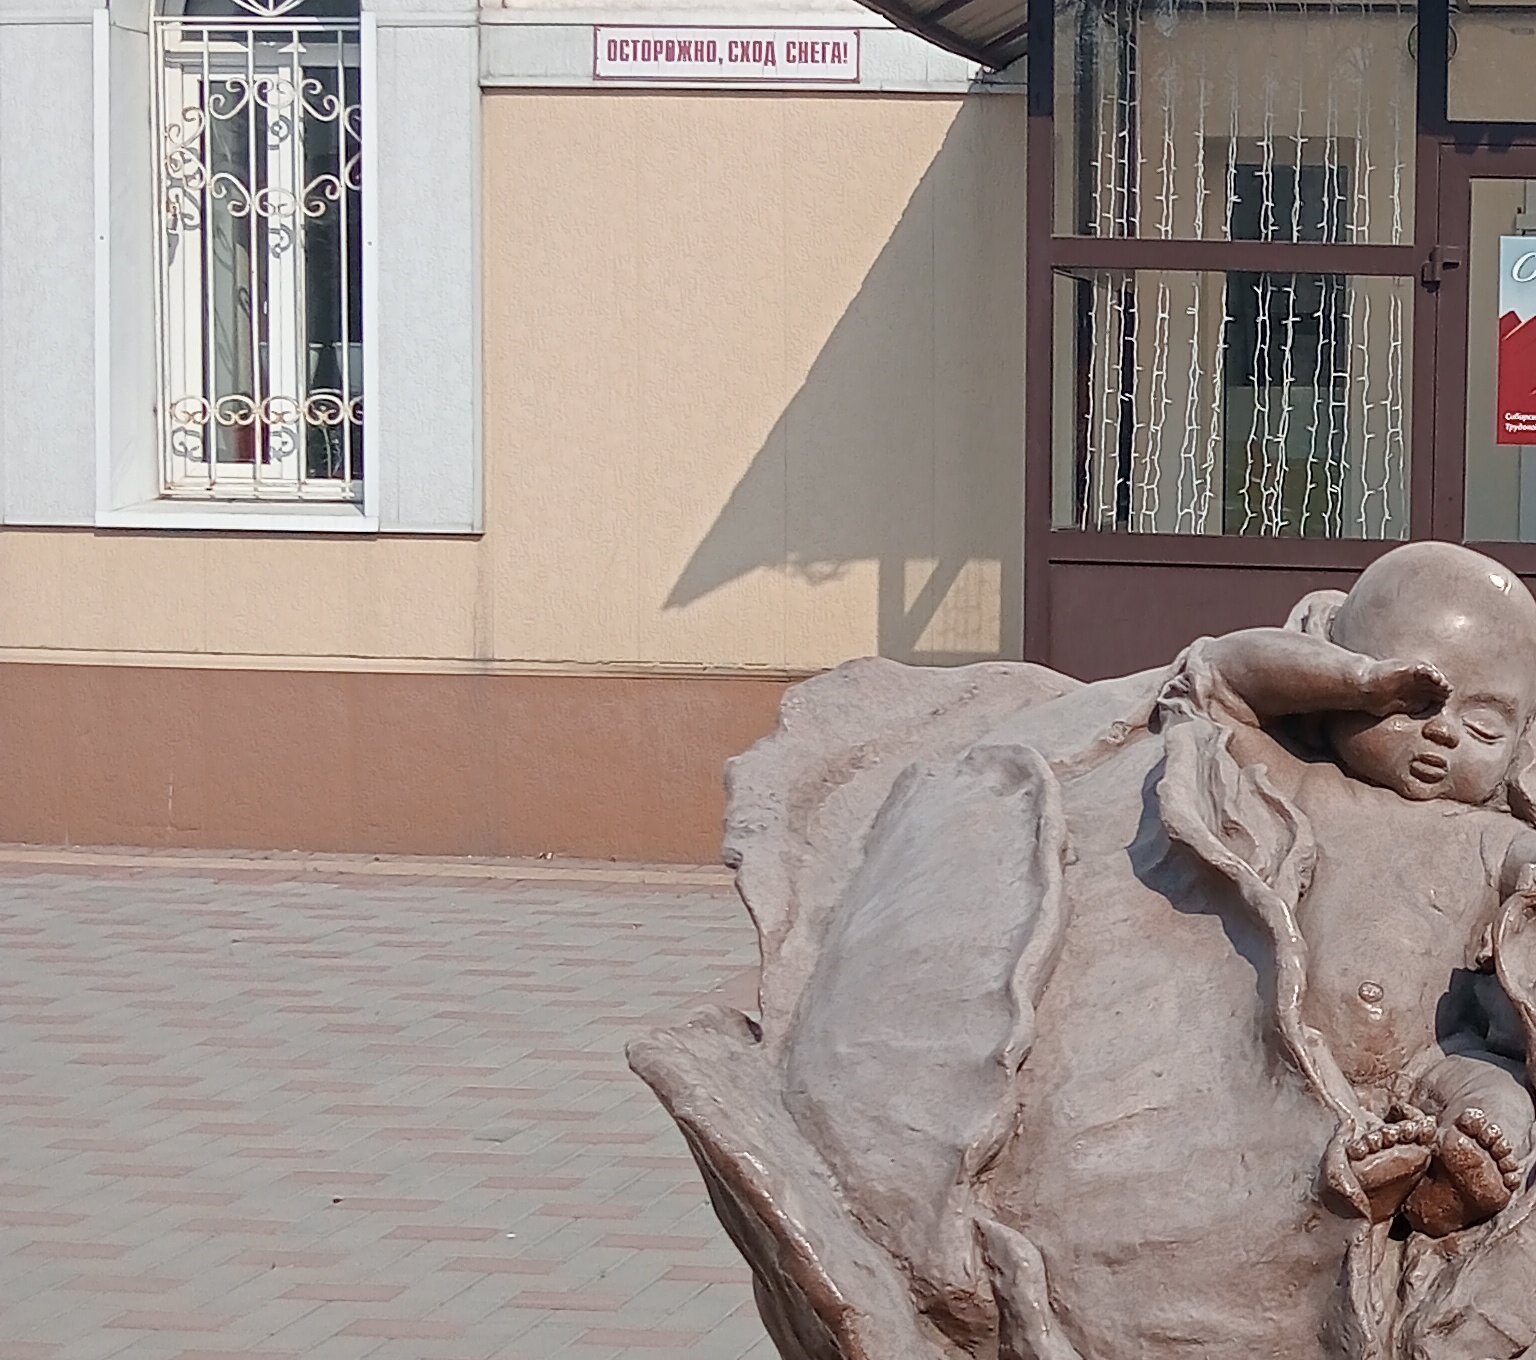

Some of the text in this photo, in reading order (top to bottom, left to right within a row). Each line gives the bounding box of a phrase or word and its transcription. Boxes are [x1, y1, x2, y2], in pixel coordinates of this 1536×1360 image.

[607, 38, 849, 67] ОСТОРОЖНО, СХОД СНЕГА!
